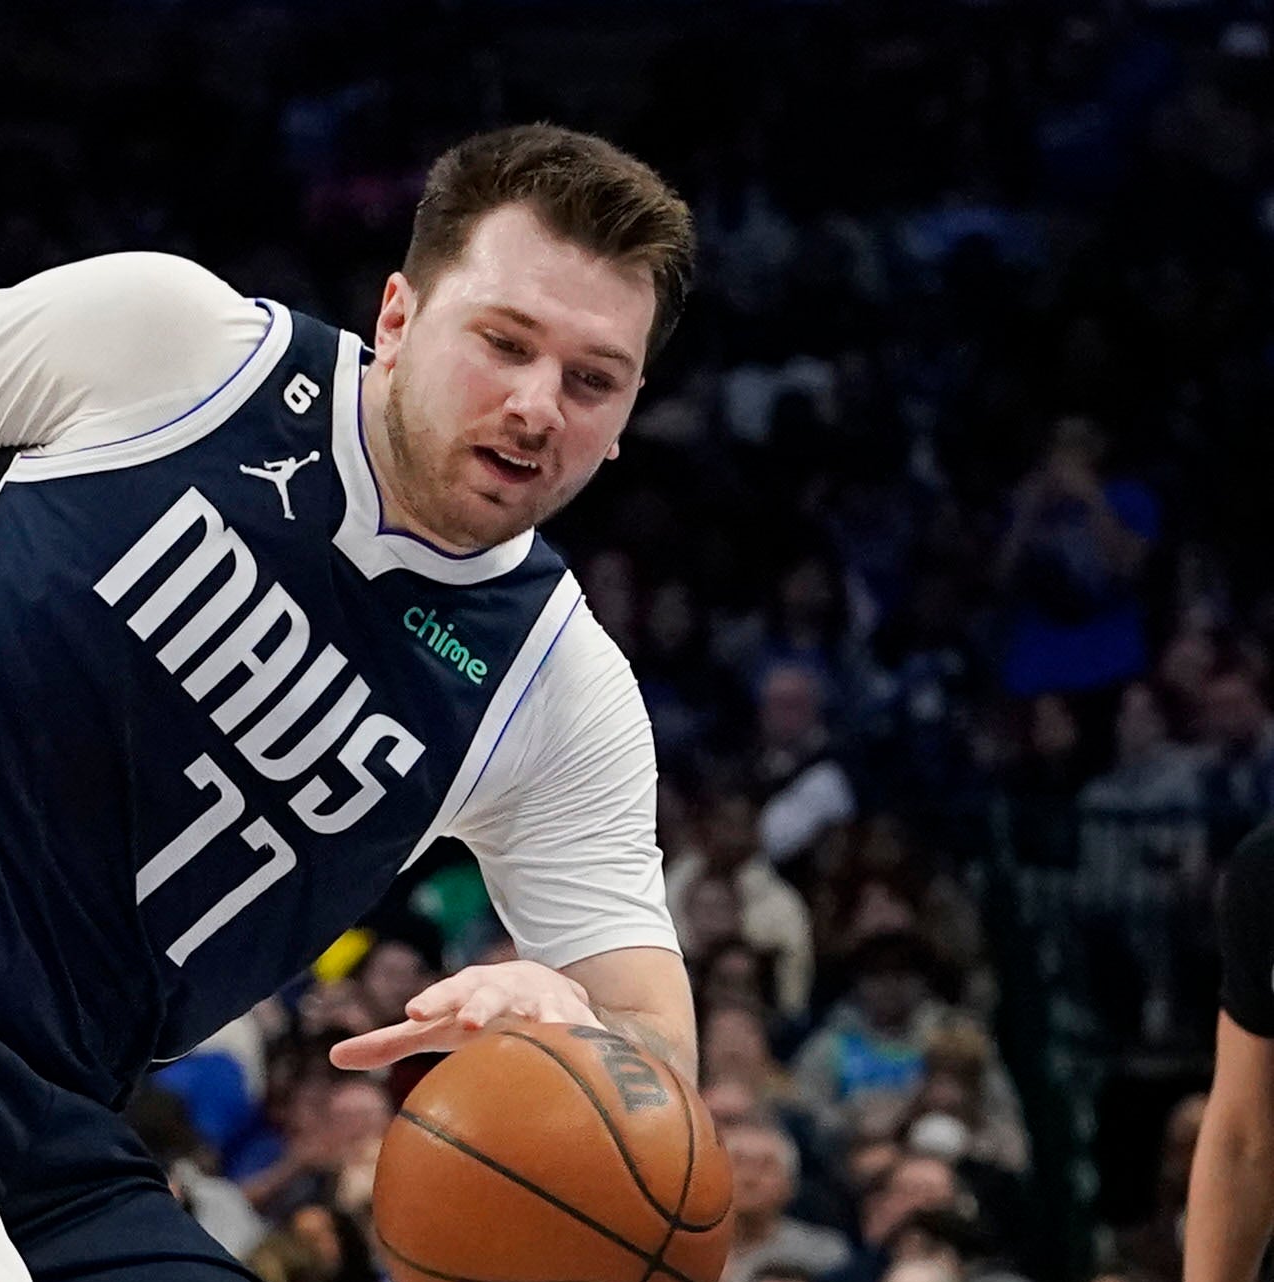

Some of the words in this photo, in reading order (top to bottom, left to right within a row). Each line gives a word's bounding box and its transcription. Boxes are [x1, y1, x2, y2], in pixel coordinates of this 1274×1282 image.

[284, 372, 320, 414] 6
[93, 486, 426, 834] MAVS
[403, 606, 488, 685] chime
[136, 752, 297, 967] 77
